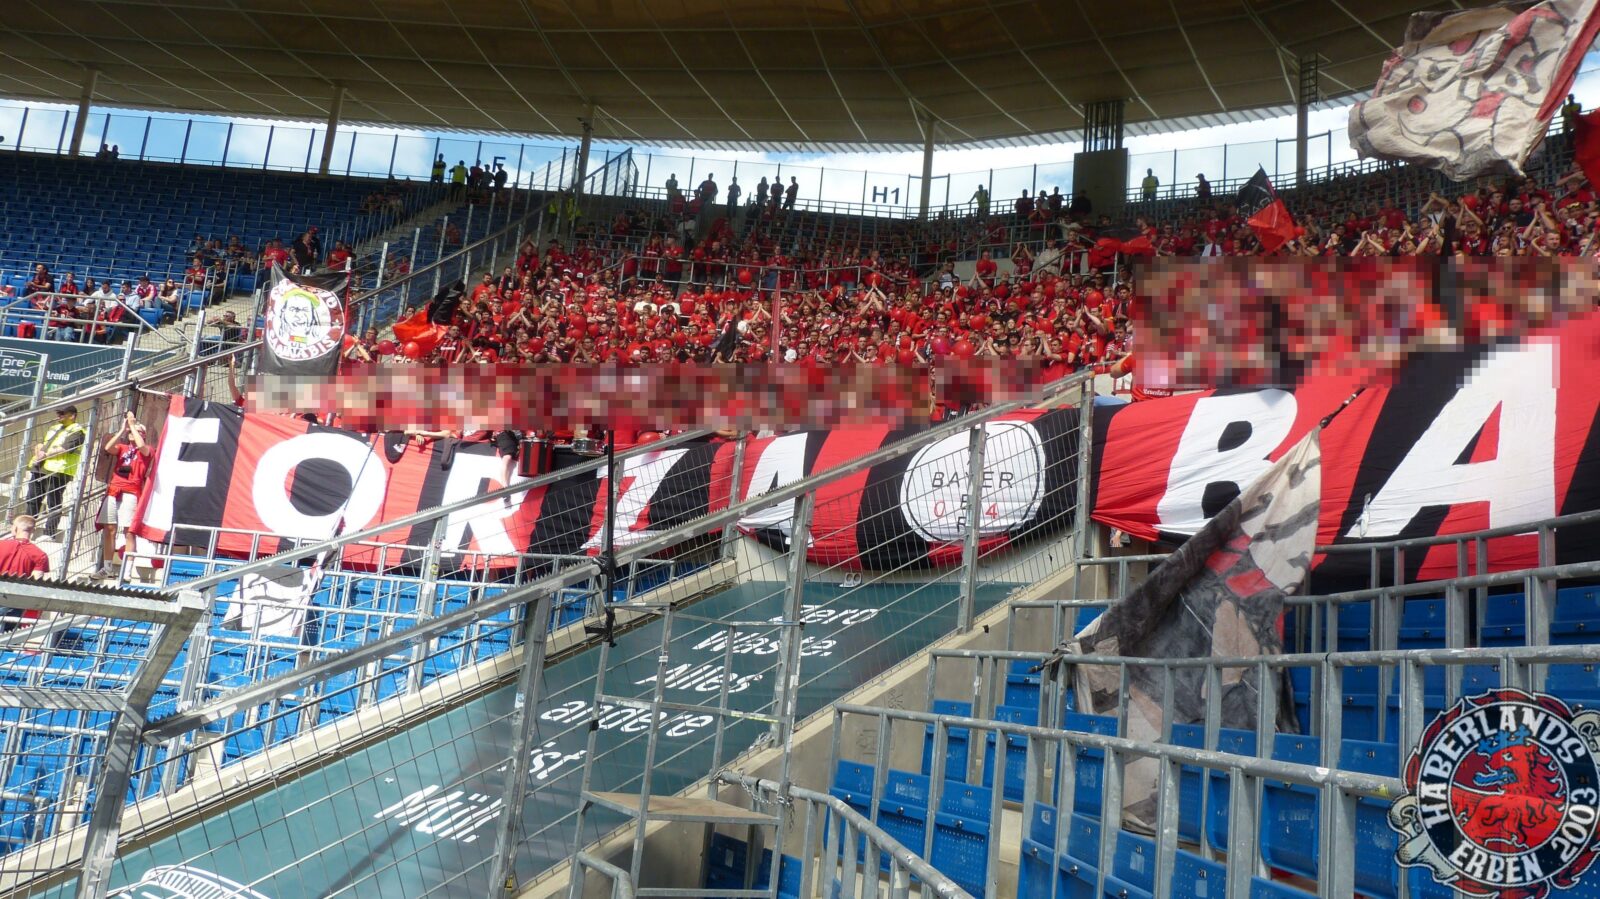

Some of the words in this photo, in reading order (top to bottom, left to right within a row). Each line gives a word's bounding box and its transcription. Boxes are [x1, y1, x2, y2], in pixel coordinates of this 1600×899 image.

[872, 185, 900, 205] H1
[1, 357, 26, 368] pre
[0, 367, 32, 378] zero
[142, 414, 815, 556] FORZA
[931, 471, 1015, 489] BAER
[634, 663, 764, 694] Alles
